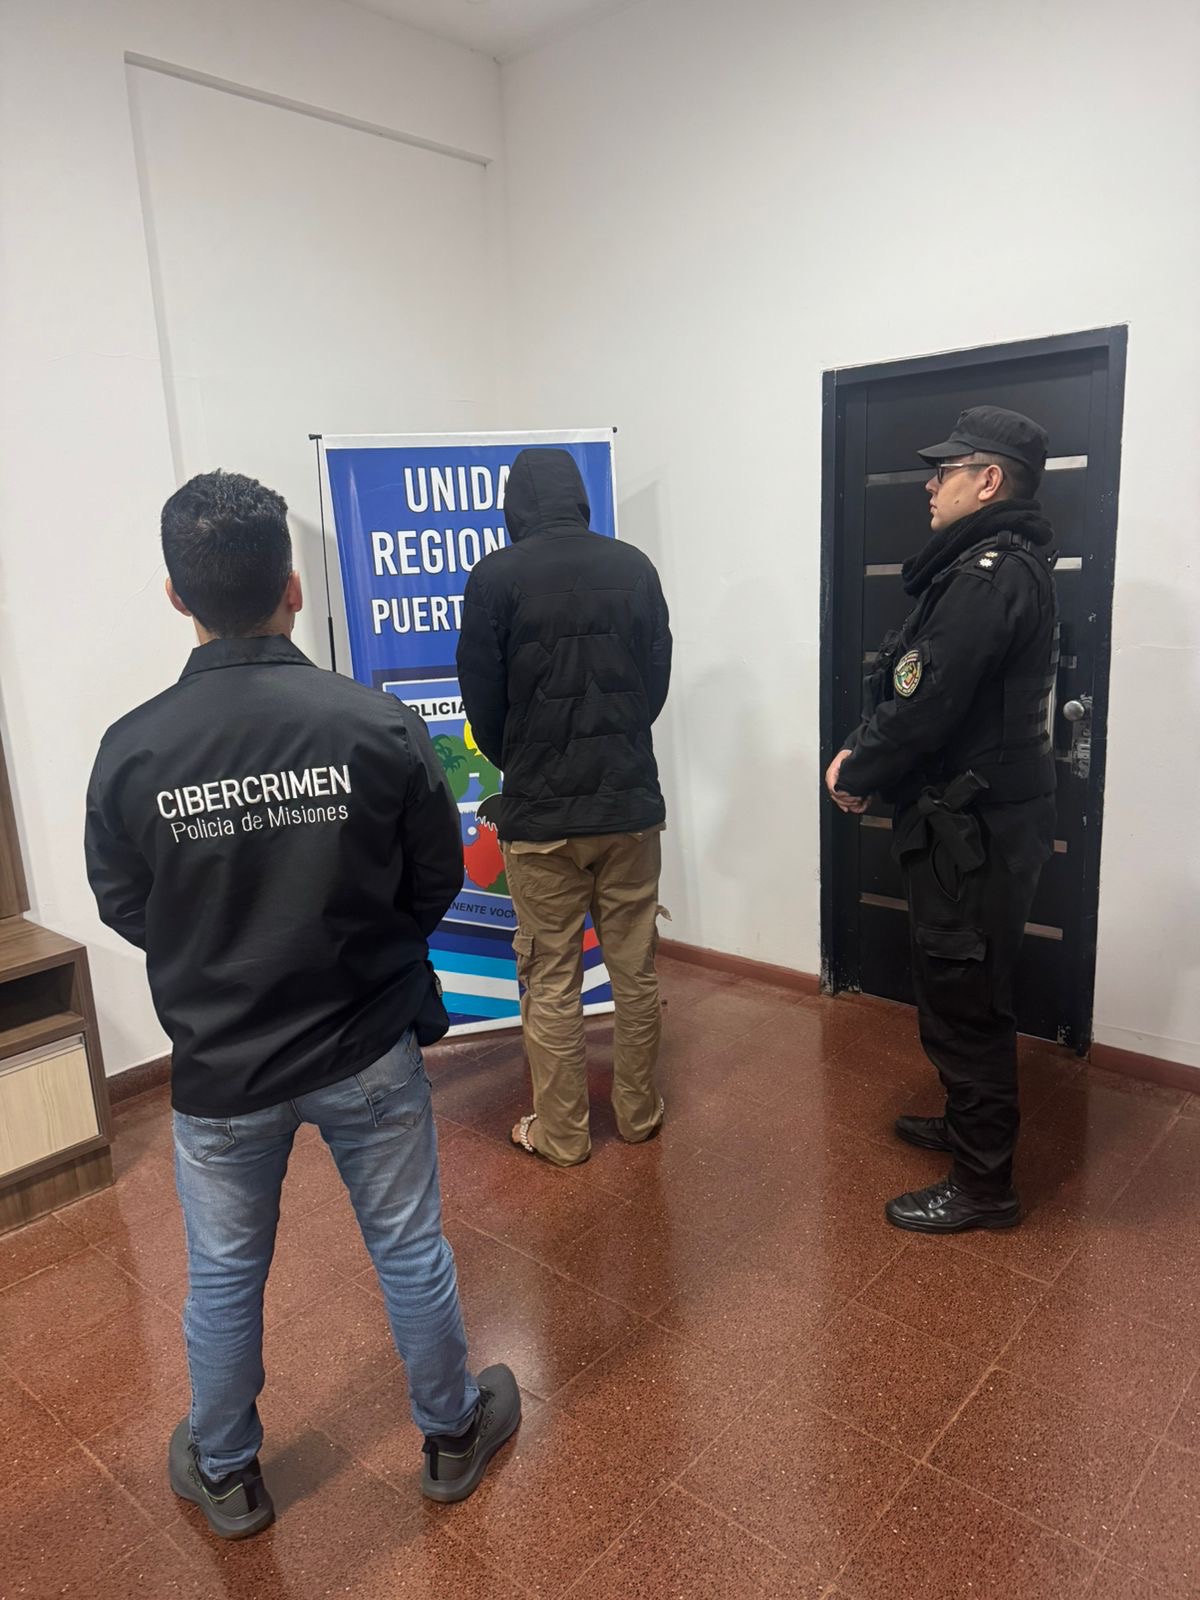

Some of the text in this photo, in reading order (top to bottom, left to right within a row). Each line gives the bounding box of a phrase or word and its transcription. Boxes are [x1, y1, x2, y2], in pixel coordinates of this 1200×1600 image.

[371, 595, 464, 633] PUERT
[156, 765, 352, 819] CIBERCRIMEN
[170, 804, 349, 843] Policia de Misiones
[450, 902, 487, 915] NENTE
